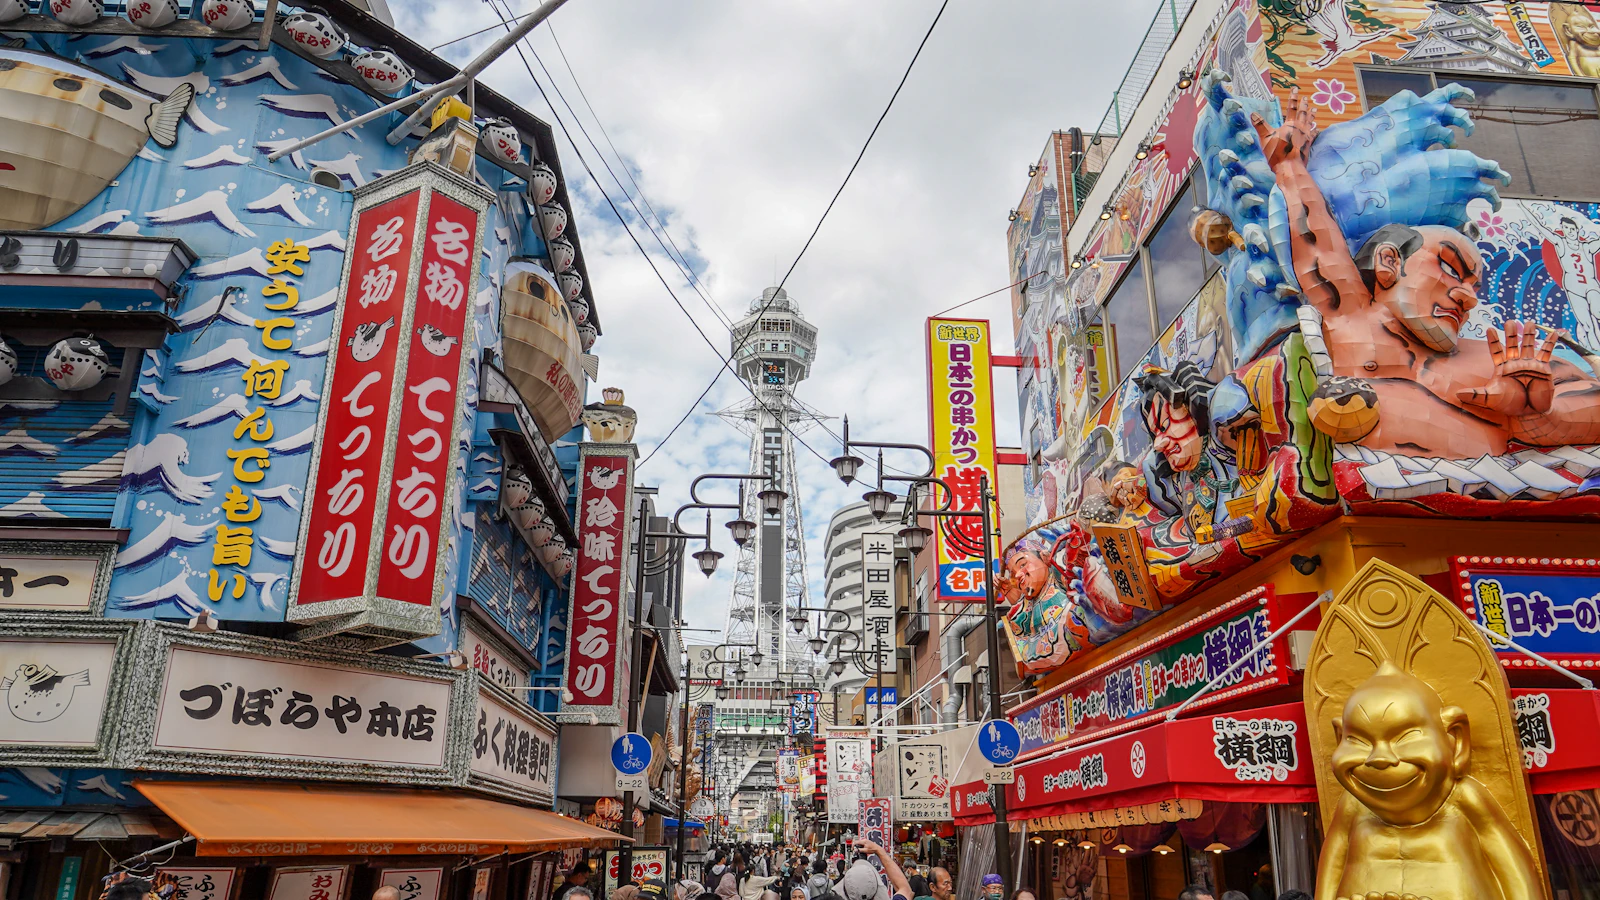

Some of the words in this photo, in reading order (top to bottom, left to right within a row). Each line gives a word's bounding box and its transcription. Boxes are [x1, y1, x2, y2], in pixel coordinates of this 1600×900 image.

[358, 215, 404, 308] 名物
[424, 216, 470, 311] 名物
[938, 325, 980, 343] 新世界
[949, 342, 977, 465] 日本一の串かつ
[318, 371, 383, 578] てっちり
[388, 376, 451, 580] てっちり
[575, 497, 618, 698] 珍味てっちり
[1506, 594, 1600, 635] 日本一の
[1105, 668, 1135, 720] 横綱
[1152, 656, 1205, 697] 日本一の串かつ
[179, 681, 437, 743] づぼらや本店
[1215, 720, 1295, 732] 日本一の串かつ
[1080, 754, 1104, 789] 横綱
[1217, 732, 1295, 768] 横綱
[1237, 767, 1270, 779] よこづな
